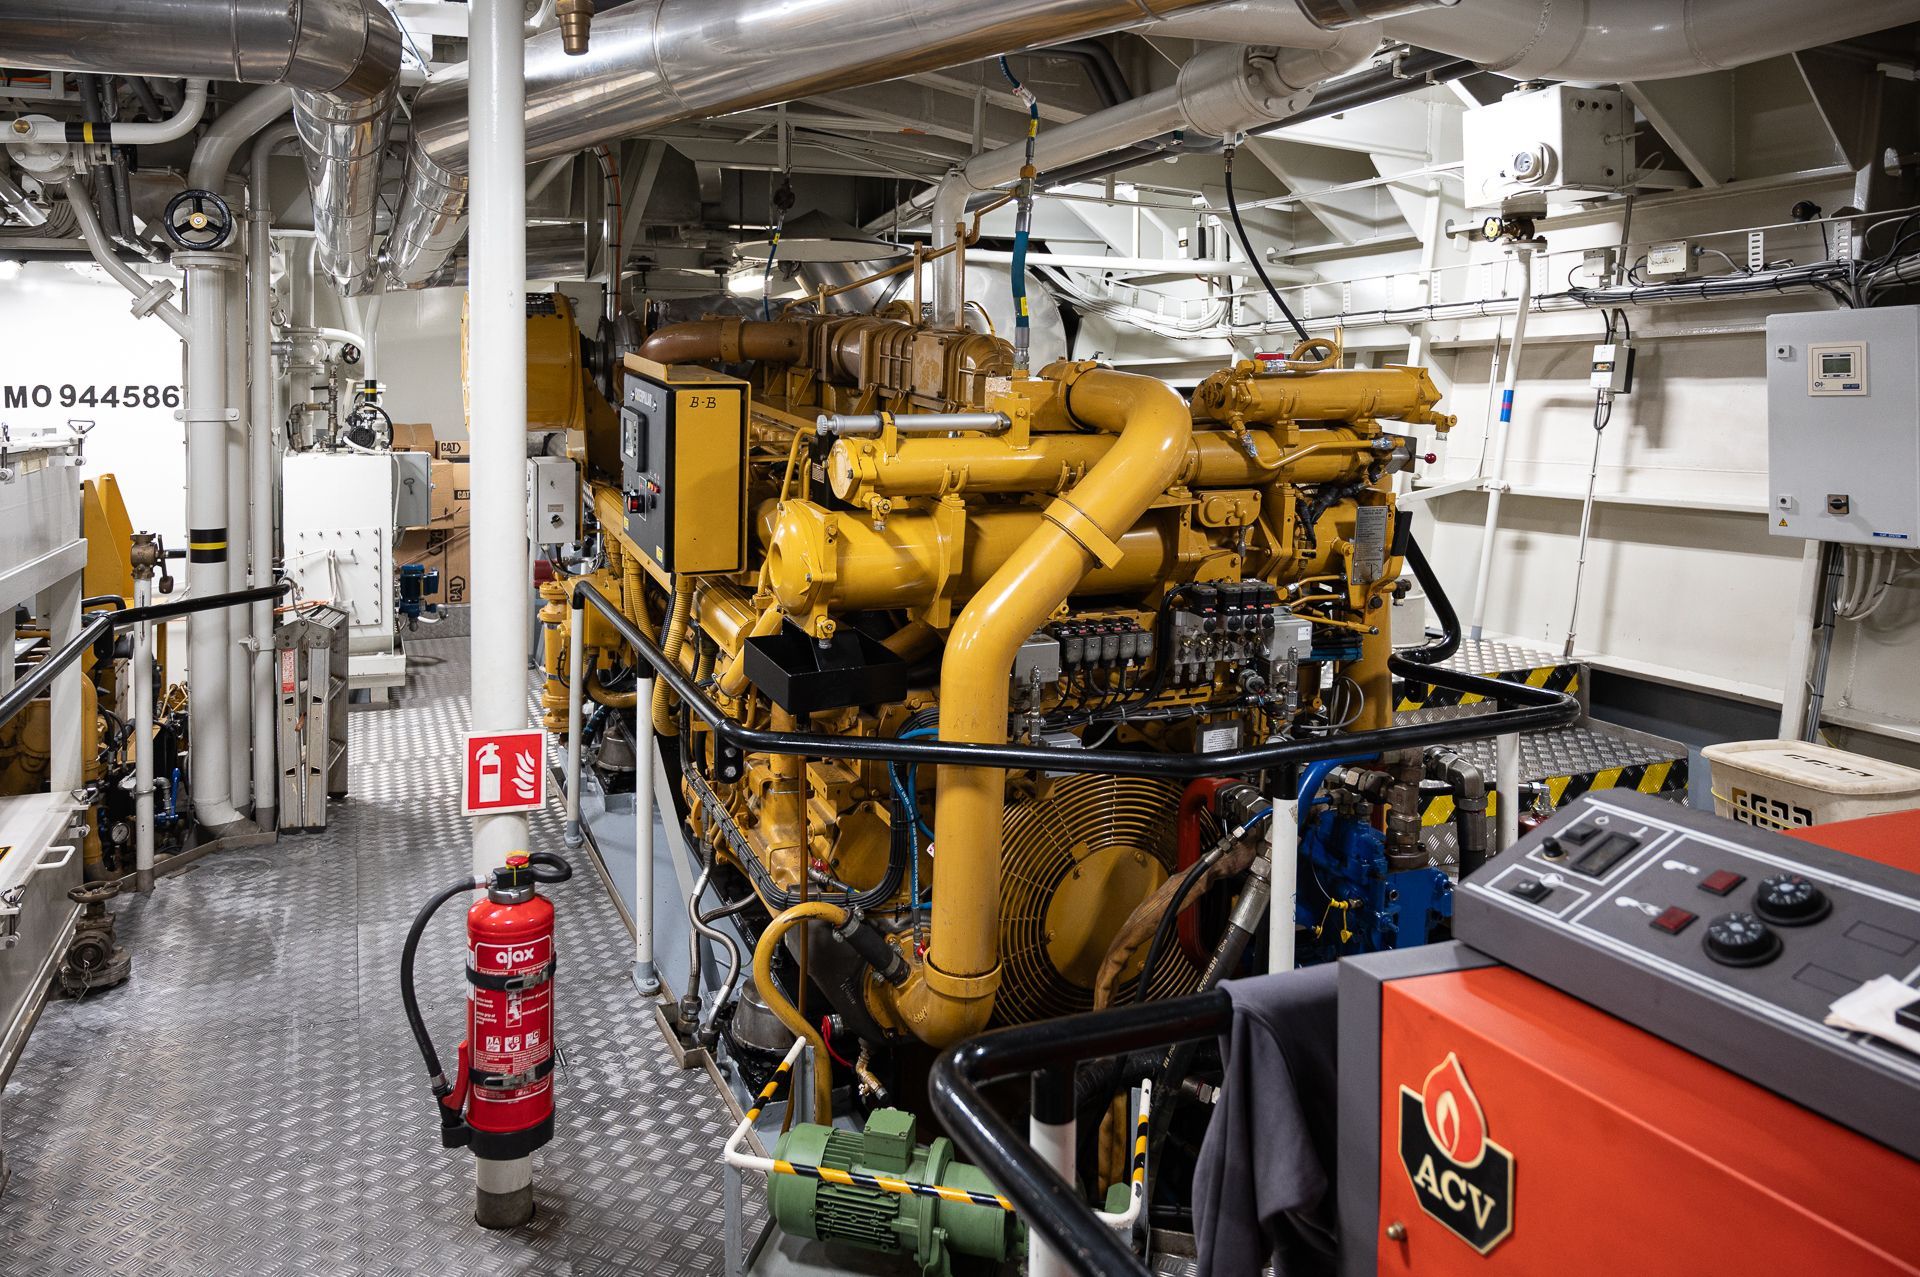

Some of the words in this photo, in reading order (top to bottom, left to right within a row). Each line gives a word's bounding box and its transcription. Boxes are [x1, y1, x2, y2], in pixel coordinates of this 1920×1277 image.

[59, 384, 180, 409] 944586
[689, 396, 717, 409] B-B
[441, 442, 457, 452] CAT
[457, 491, 471, 499] CAT
[449, 582, 463, 603] CAT
[495, 946, 535, 970] ajax
[1413, 1153, 1496, 1231] ACV
